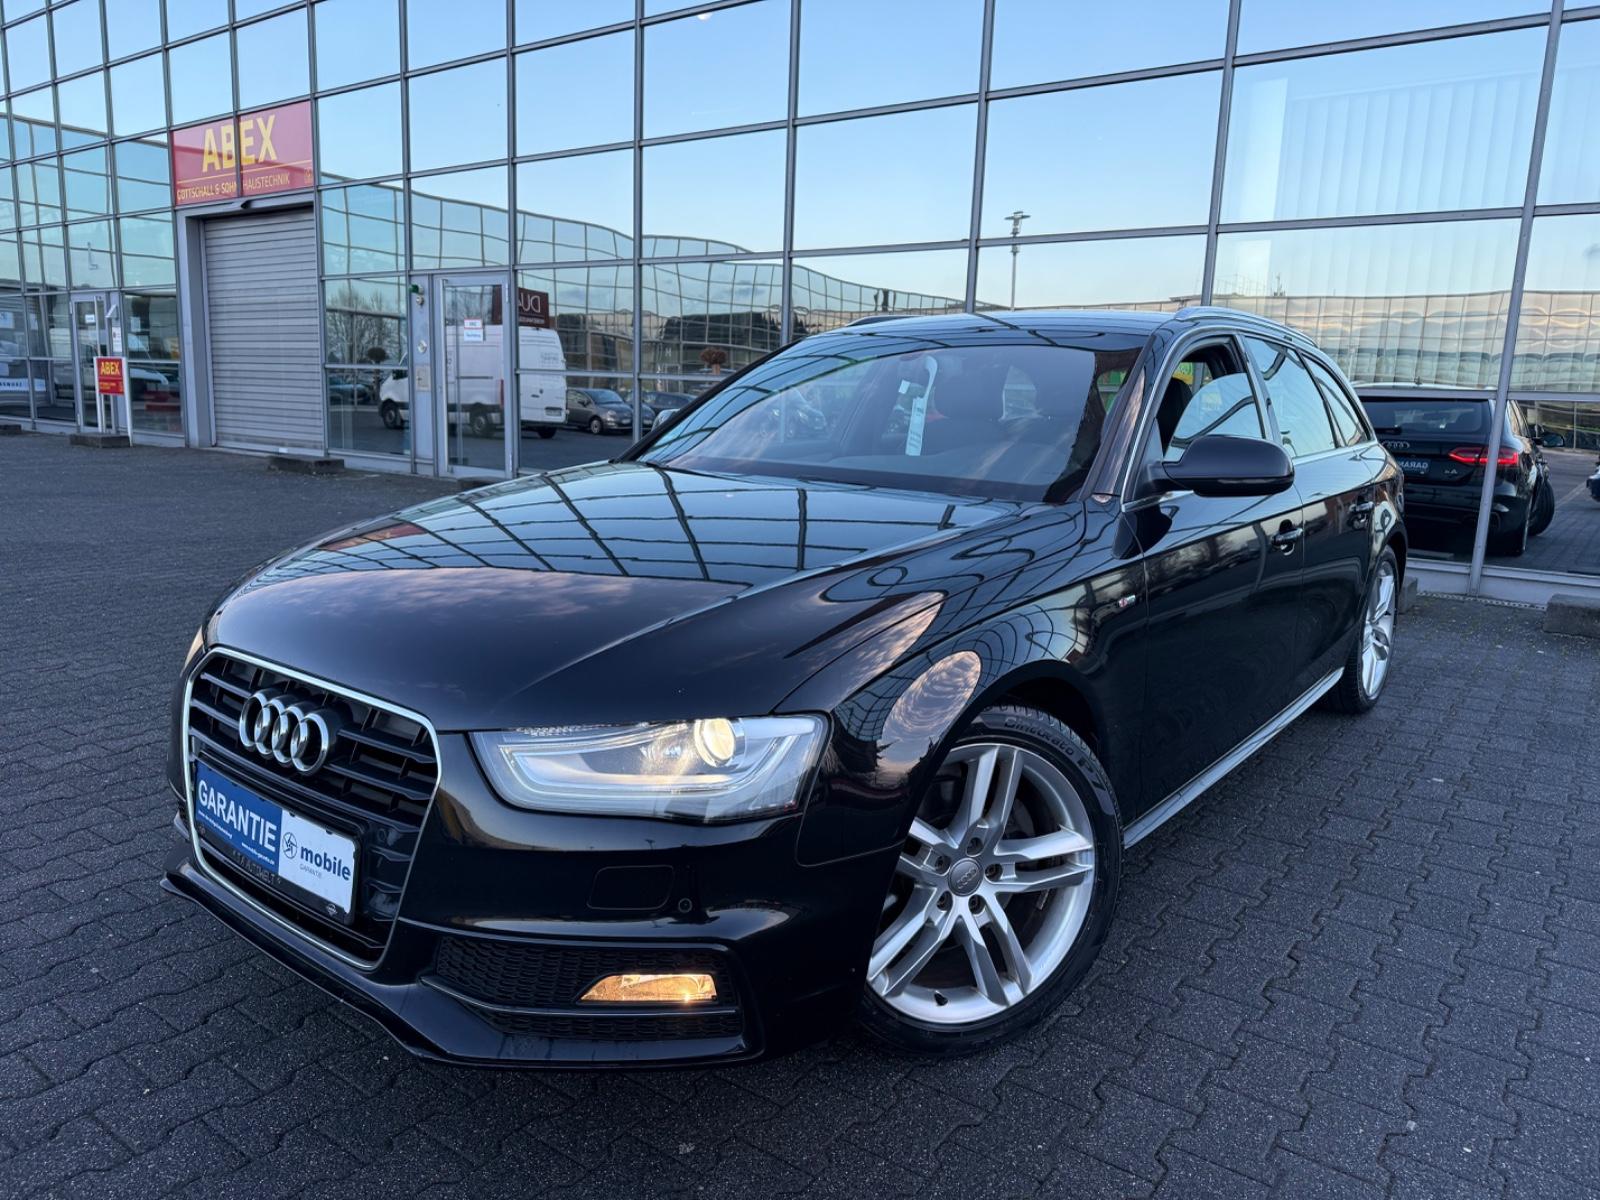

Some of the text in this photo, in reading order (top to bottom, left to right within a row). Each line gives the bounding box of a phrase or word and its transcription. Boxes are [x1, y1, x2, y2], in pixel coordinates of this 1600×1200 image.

[202, 115, 277, 173] ABEX
[177, 183, 215, 200] GOTTSCHALL
[100, 361, 121, 376] ABEX
[198, 779, 278, 853] GARANTIE
[300, 846, 352, 881] mobile
